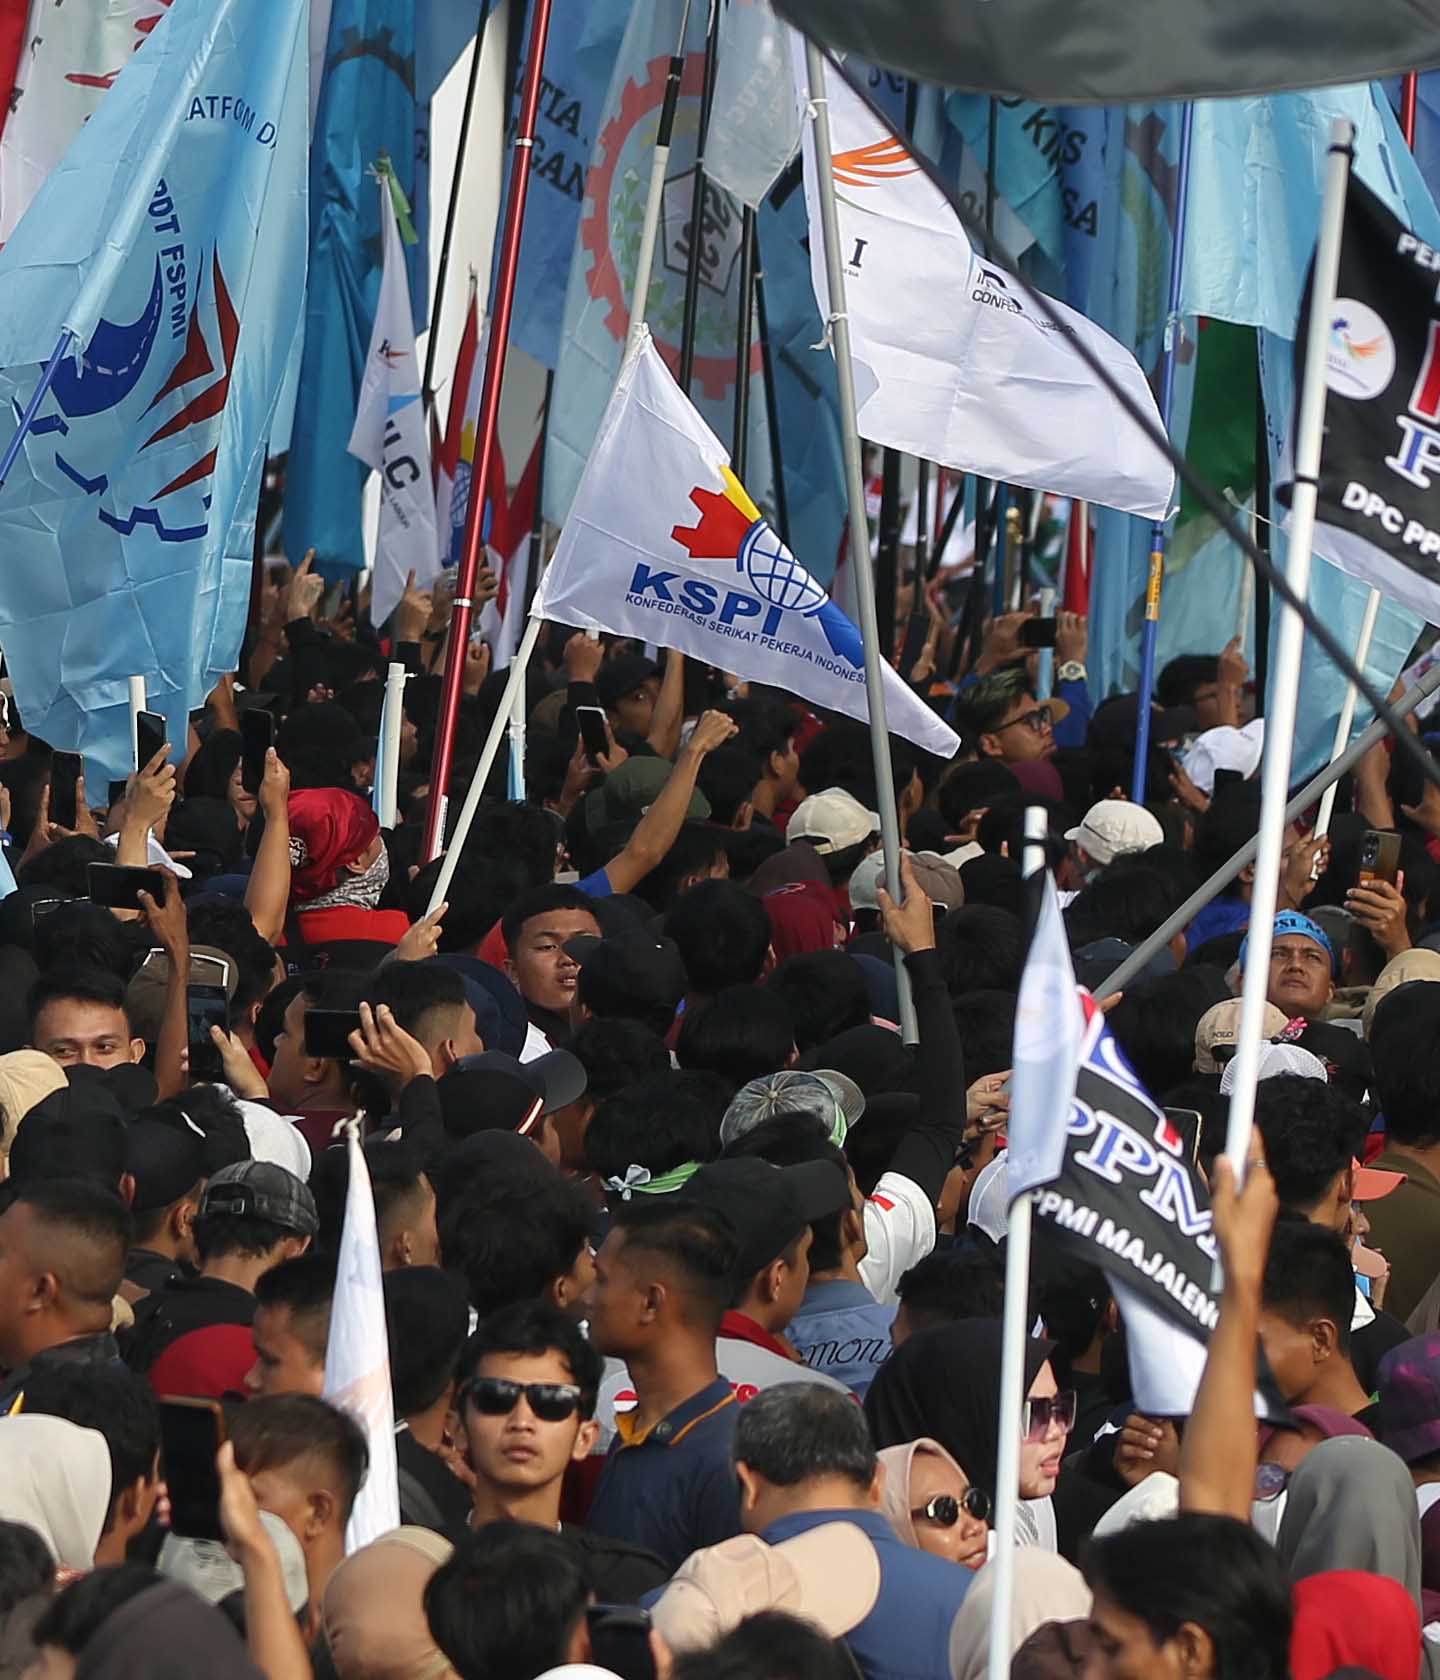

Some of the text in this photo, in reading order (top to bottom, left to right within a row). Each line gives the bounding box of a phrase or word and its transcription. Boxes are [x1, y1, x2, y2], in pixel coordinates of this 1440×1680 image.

[1343, 482, 1403, 534] DPC
[625, 593, 867, 685] KONFEDERASI SERIKAT PEKERJA INDONES
[630, 562, 783, 637] KSPI
[1097, 1222, 1219, 1330] MAJALEN
